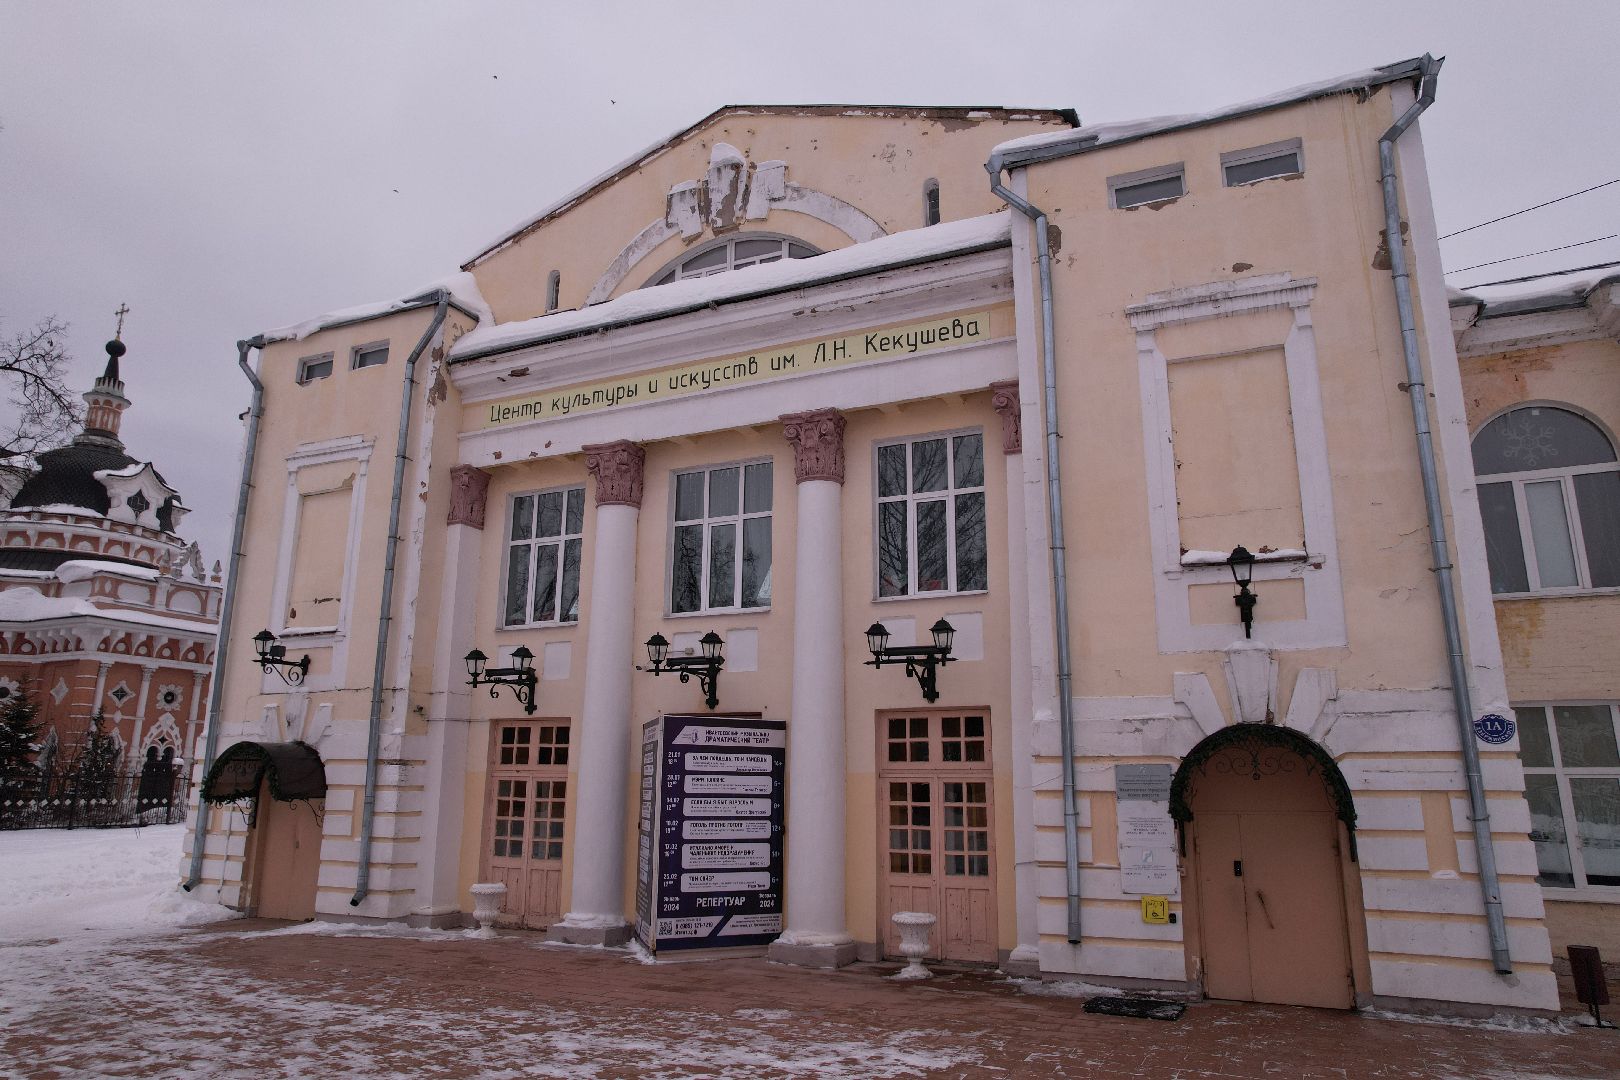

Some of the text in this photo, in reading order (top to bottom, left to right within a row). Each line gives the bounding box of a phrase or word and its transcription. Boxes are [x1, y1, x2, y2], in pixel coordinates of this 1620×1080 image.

[490, 318, 980, 423] Центр культуры и искусств им. Л.Н. Кекушева
[696, 896, 746, 908] РЕПЕРТУАР
[759, 900, 775, 908] 2024
[663, 903, 680, 912] 2024
